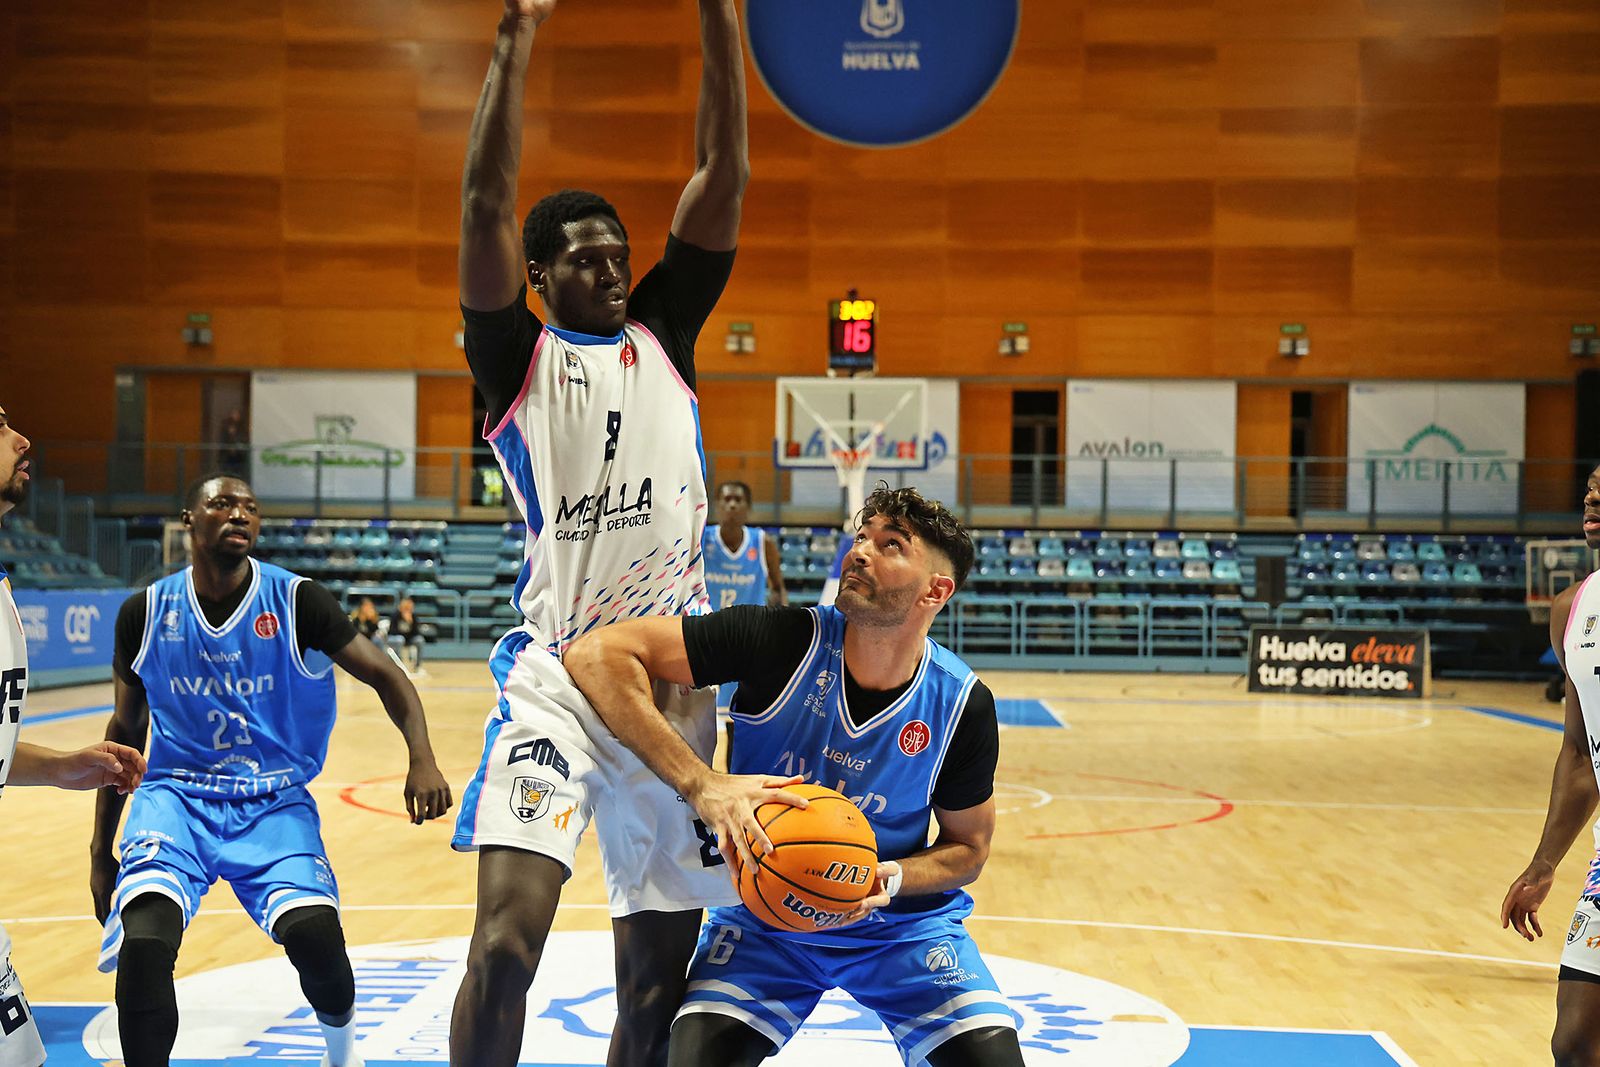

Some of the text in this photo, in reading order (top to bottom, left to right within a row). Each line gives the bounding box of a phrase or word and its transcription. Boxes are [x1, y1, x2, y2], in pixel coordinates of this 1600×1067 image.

[842, 53, 920, 70] HUELVA
[843, 320, 872, 353] 16
[606, 512, 652, 532] DEPORTE
[1259, 635, 1417, 665] Huelva eleva
[1258, 662, 1298, 687] tus
[207, 709, 253, 750] 23
[507, 737, 571, 782] CMB
[823, 861, 871, 886] EVO
[782, 891, 844, 928] ilson
[707, 925, 741, 966] 6
